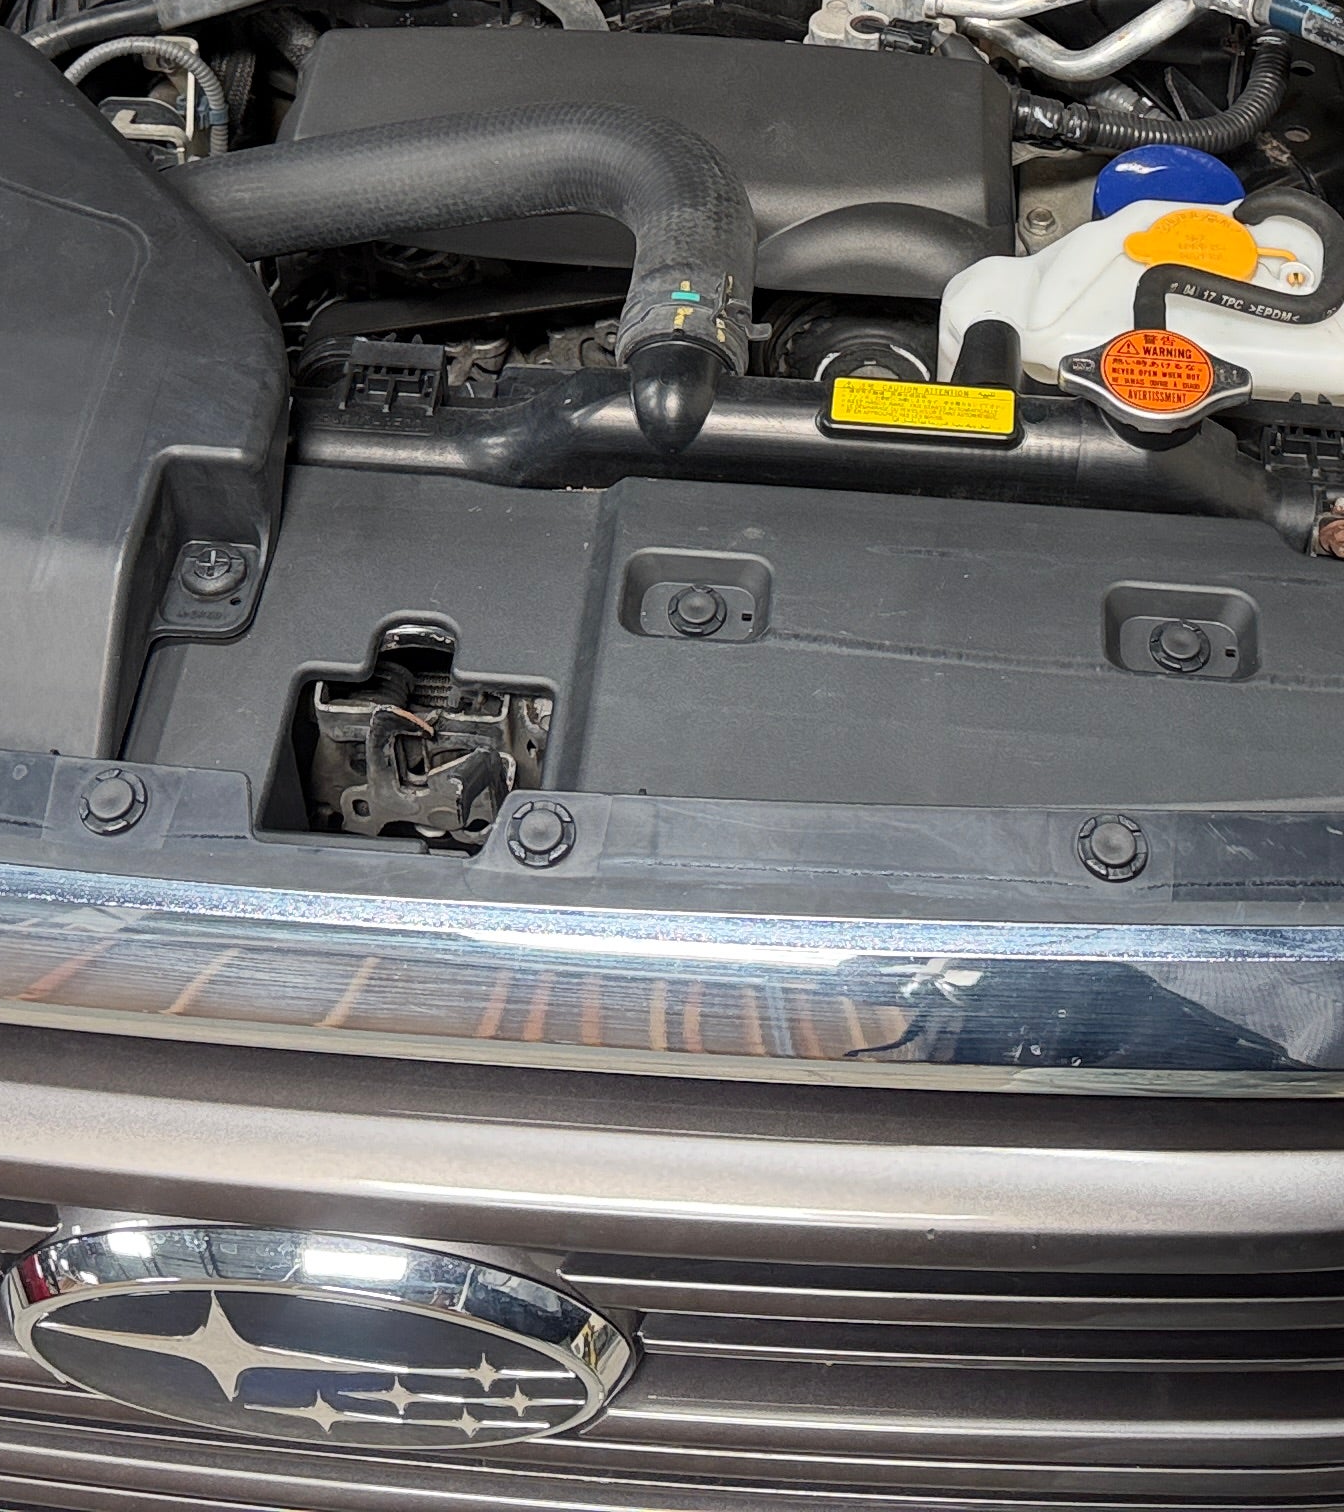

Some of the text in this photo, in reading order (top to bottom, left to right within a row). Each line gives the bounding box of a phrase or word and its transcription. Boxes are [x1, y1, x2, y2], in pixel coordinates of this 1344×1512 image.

[1201, 288, 1217, 302] 17
[1219, 294, 1244, 310] TPC
[1247, 301, 1300, 326] >EPDM<
[1142, 346, 1192, 359] WARNING
[882, 384, 919, 394] CAUTION
[925, 388, 969, 398] ATTENTION
